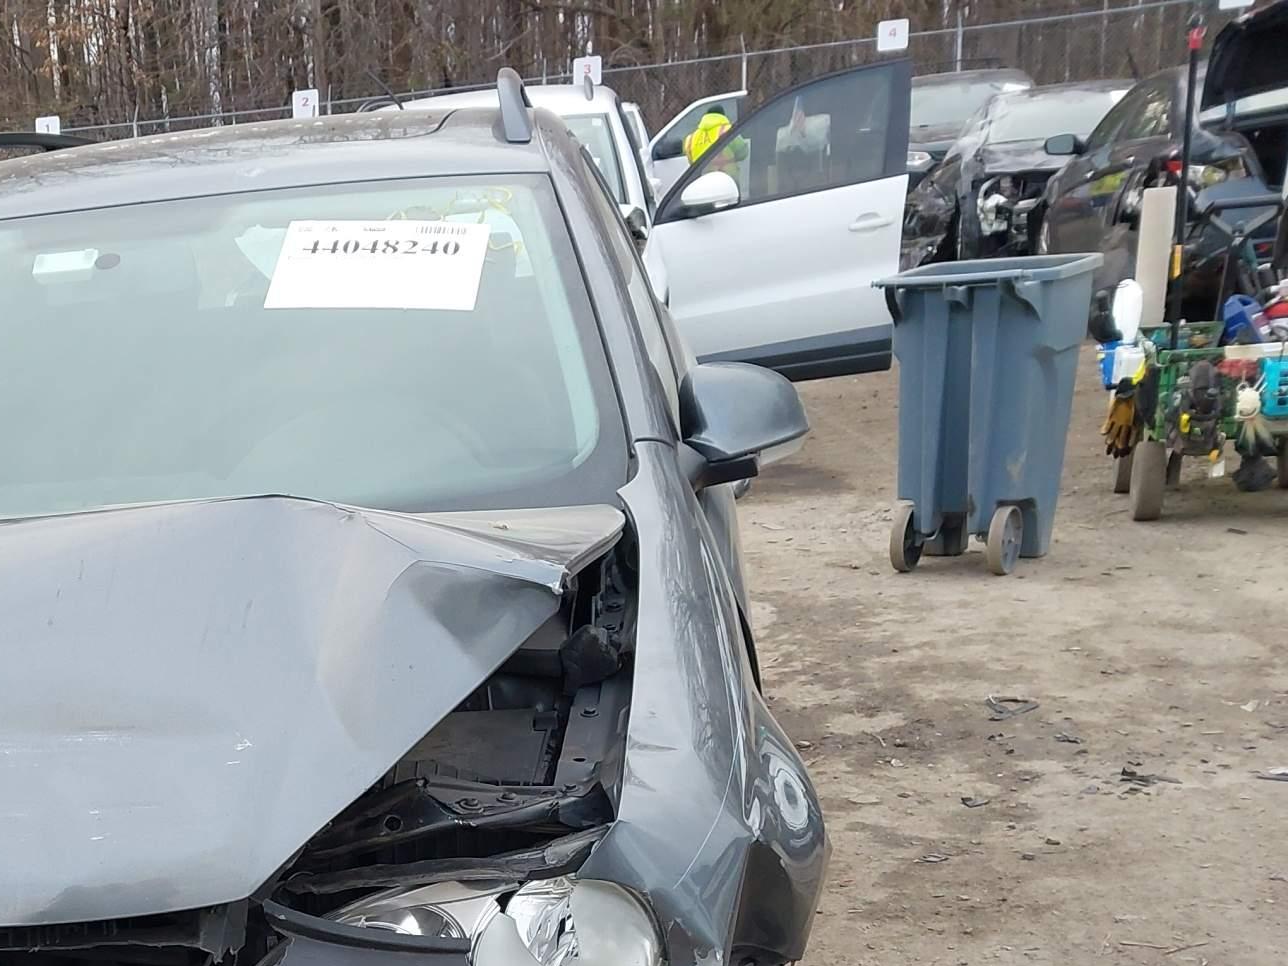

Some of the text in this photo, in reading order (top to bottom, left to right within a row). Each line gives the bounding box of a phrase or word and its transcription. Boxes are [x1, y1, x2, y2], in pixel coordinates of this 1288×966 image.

[584, 64, 591, 74] 3
[302, 97, 309, 106] 2
[303, 239, 460, 255] 44048240
